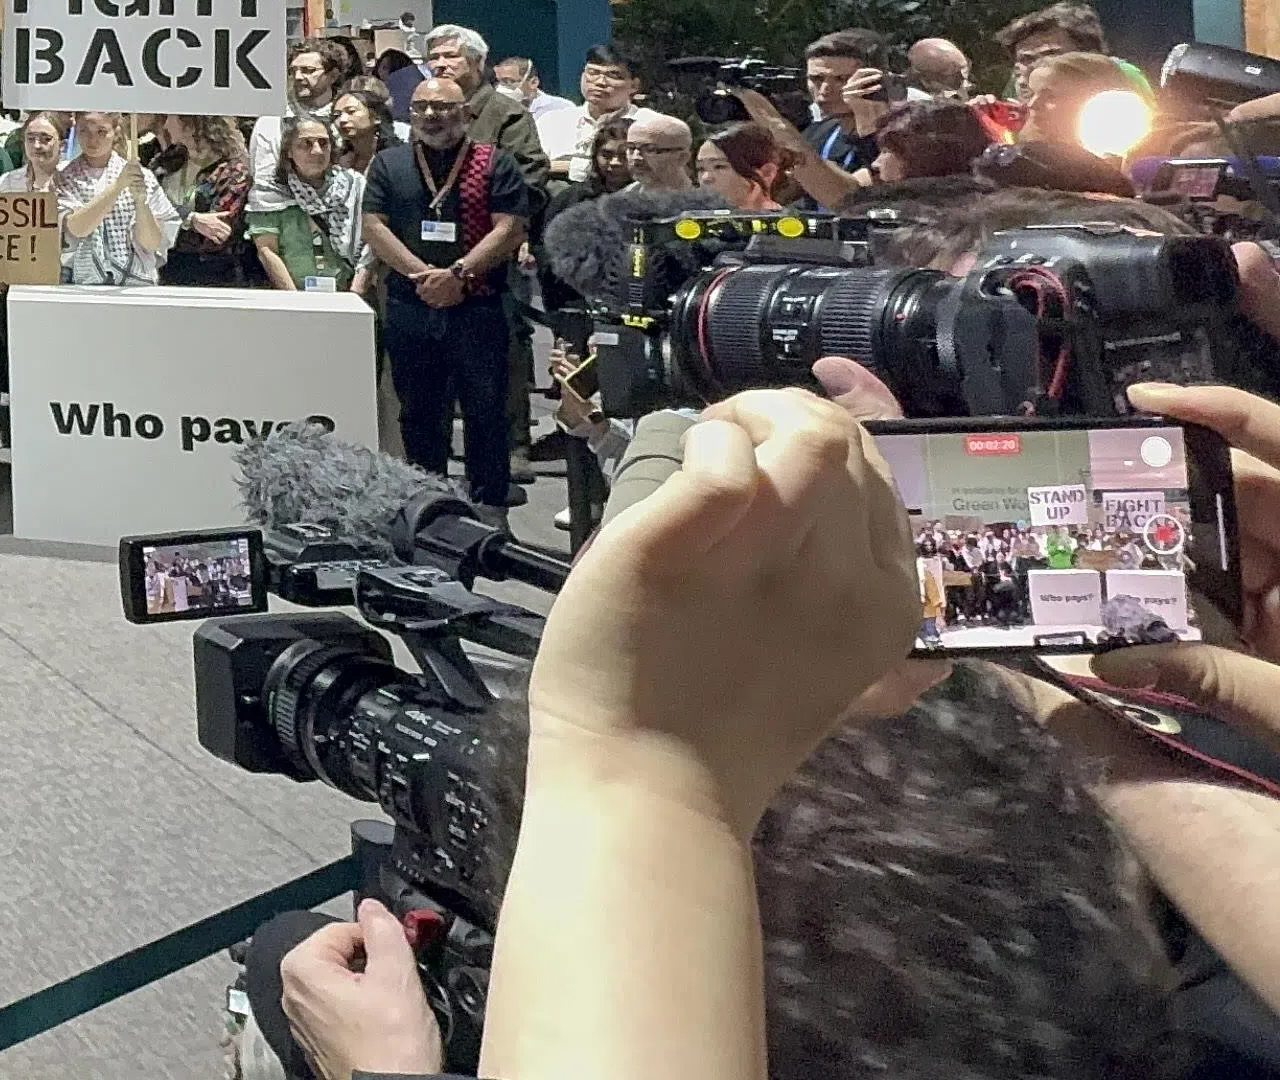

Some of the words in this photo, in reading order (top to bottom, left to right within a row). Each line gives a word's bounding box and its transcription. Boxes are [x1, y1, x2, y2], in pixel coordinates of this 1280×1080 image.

[15, 27, 273, 89] BACK
[49, 401, 165, 439] Who
[180, 414, 336, 452] pay?
[1029, 488, 1085, 505] STAND
[1046, 506, 1070, 521] UP
[1105, 499, 1162, 514] FIGHT
[1105, 514, 1152, 529] BAC
